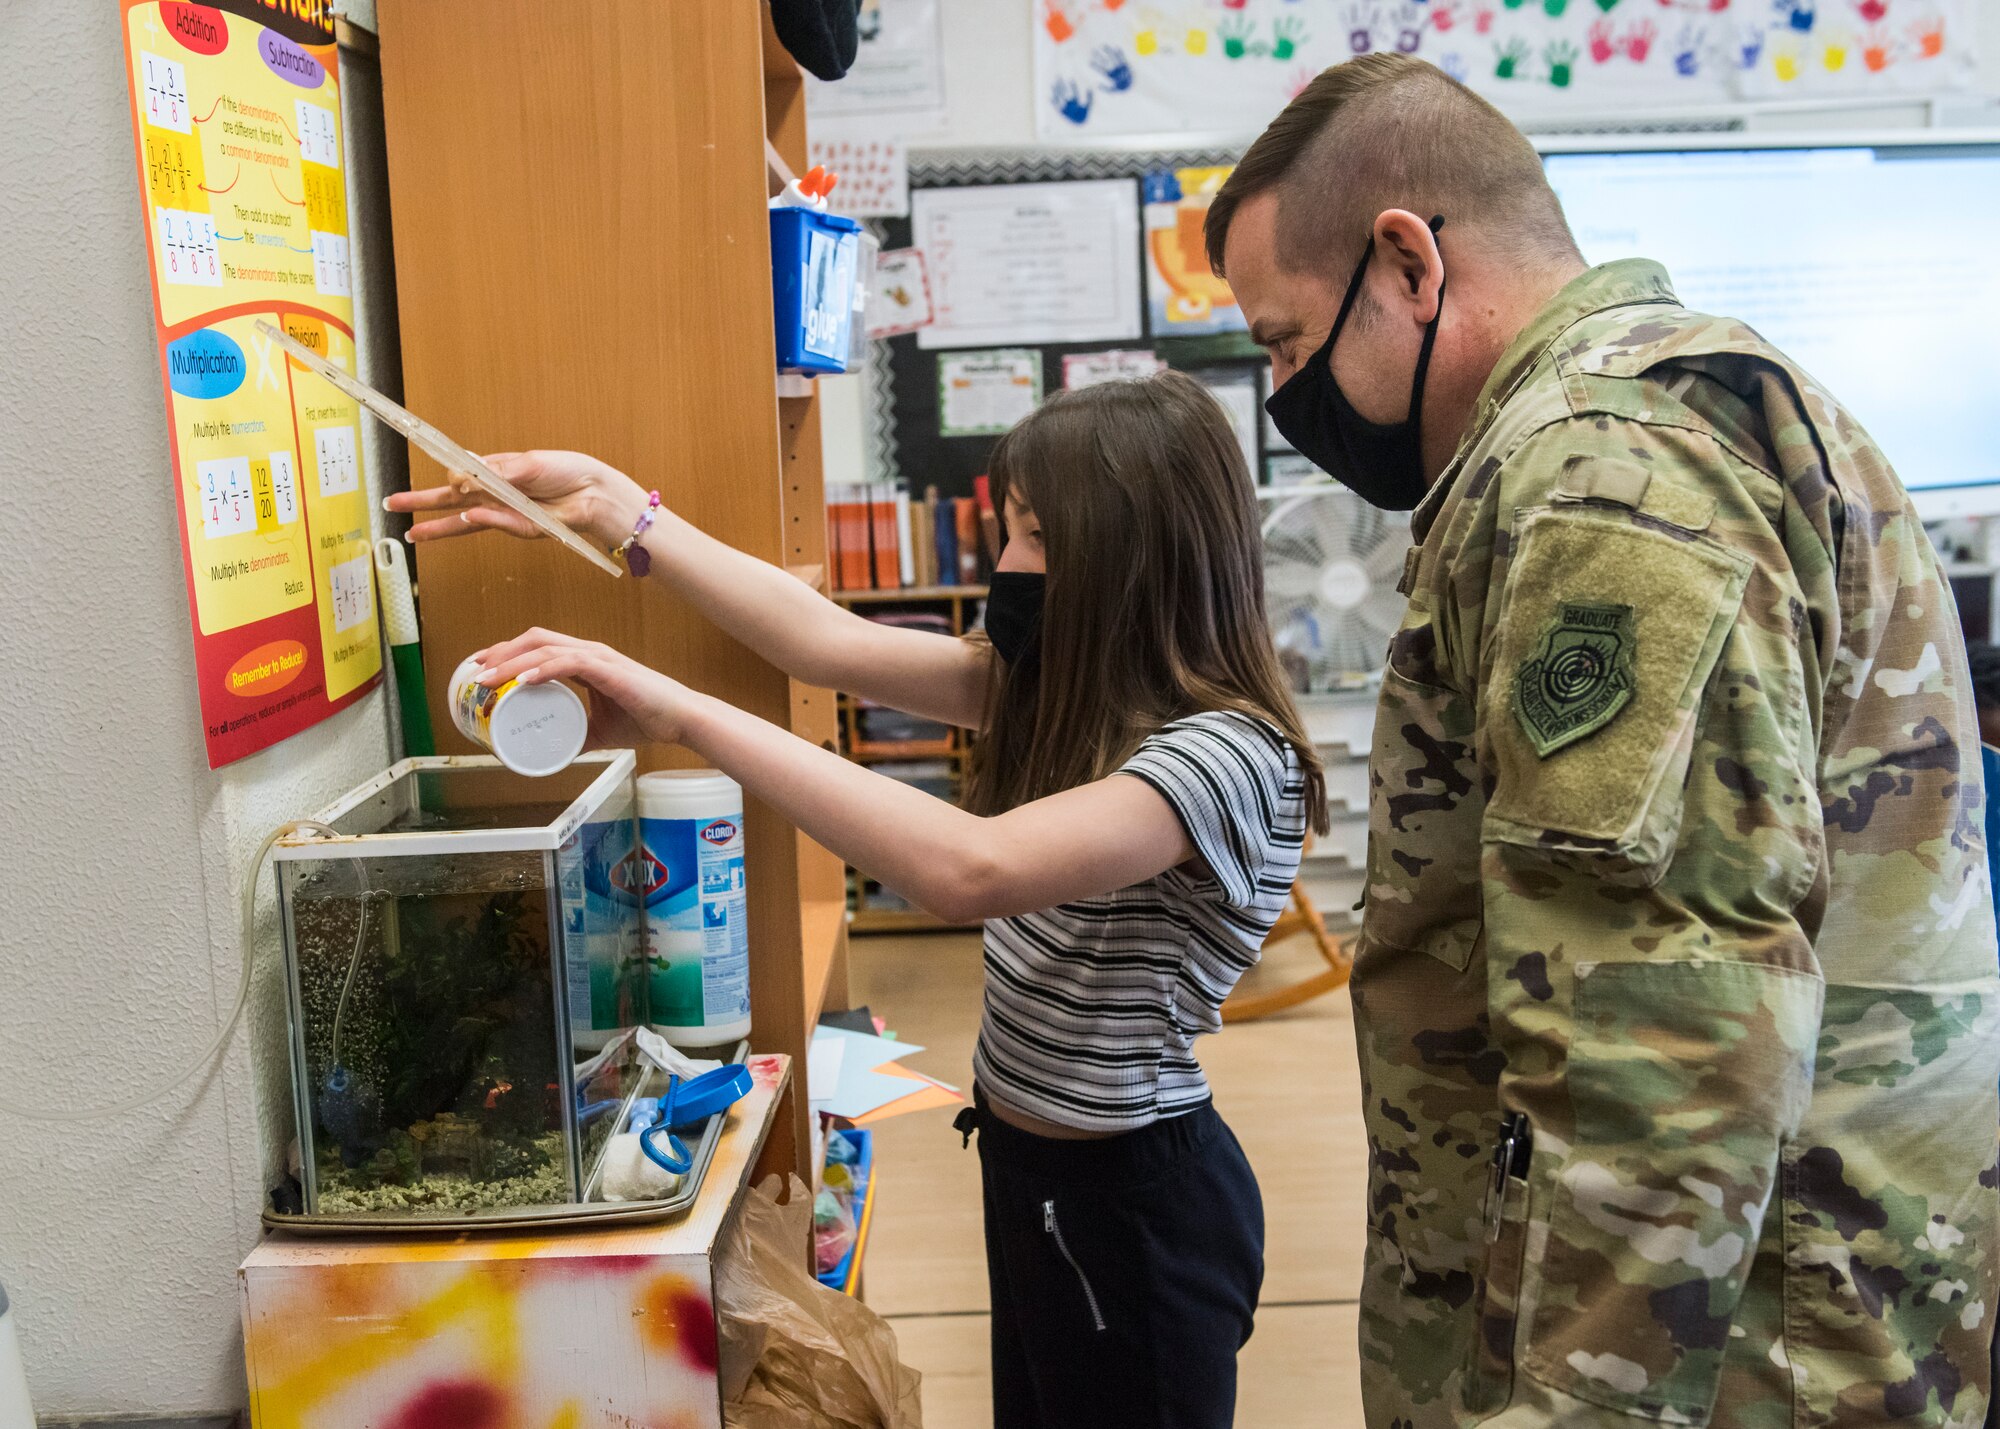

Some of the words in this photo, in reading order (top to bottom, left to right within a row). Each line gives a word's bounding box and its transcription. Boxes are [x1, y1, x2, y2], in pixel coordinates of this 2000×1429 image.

[176, 7, 218, 44] Addition
[268, 41, 317, 78] Subtraction
[227, 96, 237, 112] the
[238, 98, 279, 124] denominators
[223, 121, 233, 134] are
[234, 120, 259, 142] different,
[260, 126, 271, 143] first
[272, 128, 284, 146] find
[226, 144, 252, 161] common
[234, 204, 249, 222] Then
[250, 207, 262, 223] add
[263, 212, 268, 224] or
[269, 209, 292, 228] subtract
[244, 227, 255, 244] the
[224, 263, 236, 279] The
[237, 262, 276, 282] denominators
[277, 268, 288, 286] stay
[289, 268, 298, 284] the
[807, 302, 838, 346] glue
[172, 349, 239, 381] Multiplication
[194, 421, 220, 440] Multiply
[220, 422, 231, 436] the
[211, 560, 238, 581] Multiply
[238, 560, 249, 574] the
[1564, 608, 1621, 627] GRADUATE
[232, 662, 271, 688] Remember
[271, 660, 279, 674] to
[279, 648, 304, 671] Reduce!
[209, 723, 219, 738] For
[220, 720, 228, 734] all
[258, 705, 275, 720] reduce
[705, 825, 734, 840] CLOROX
